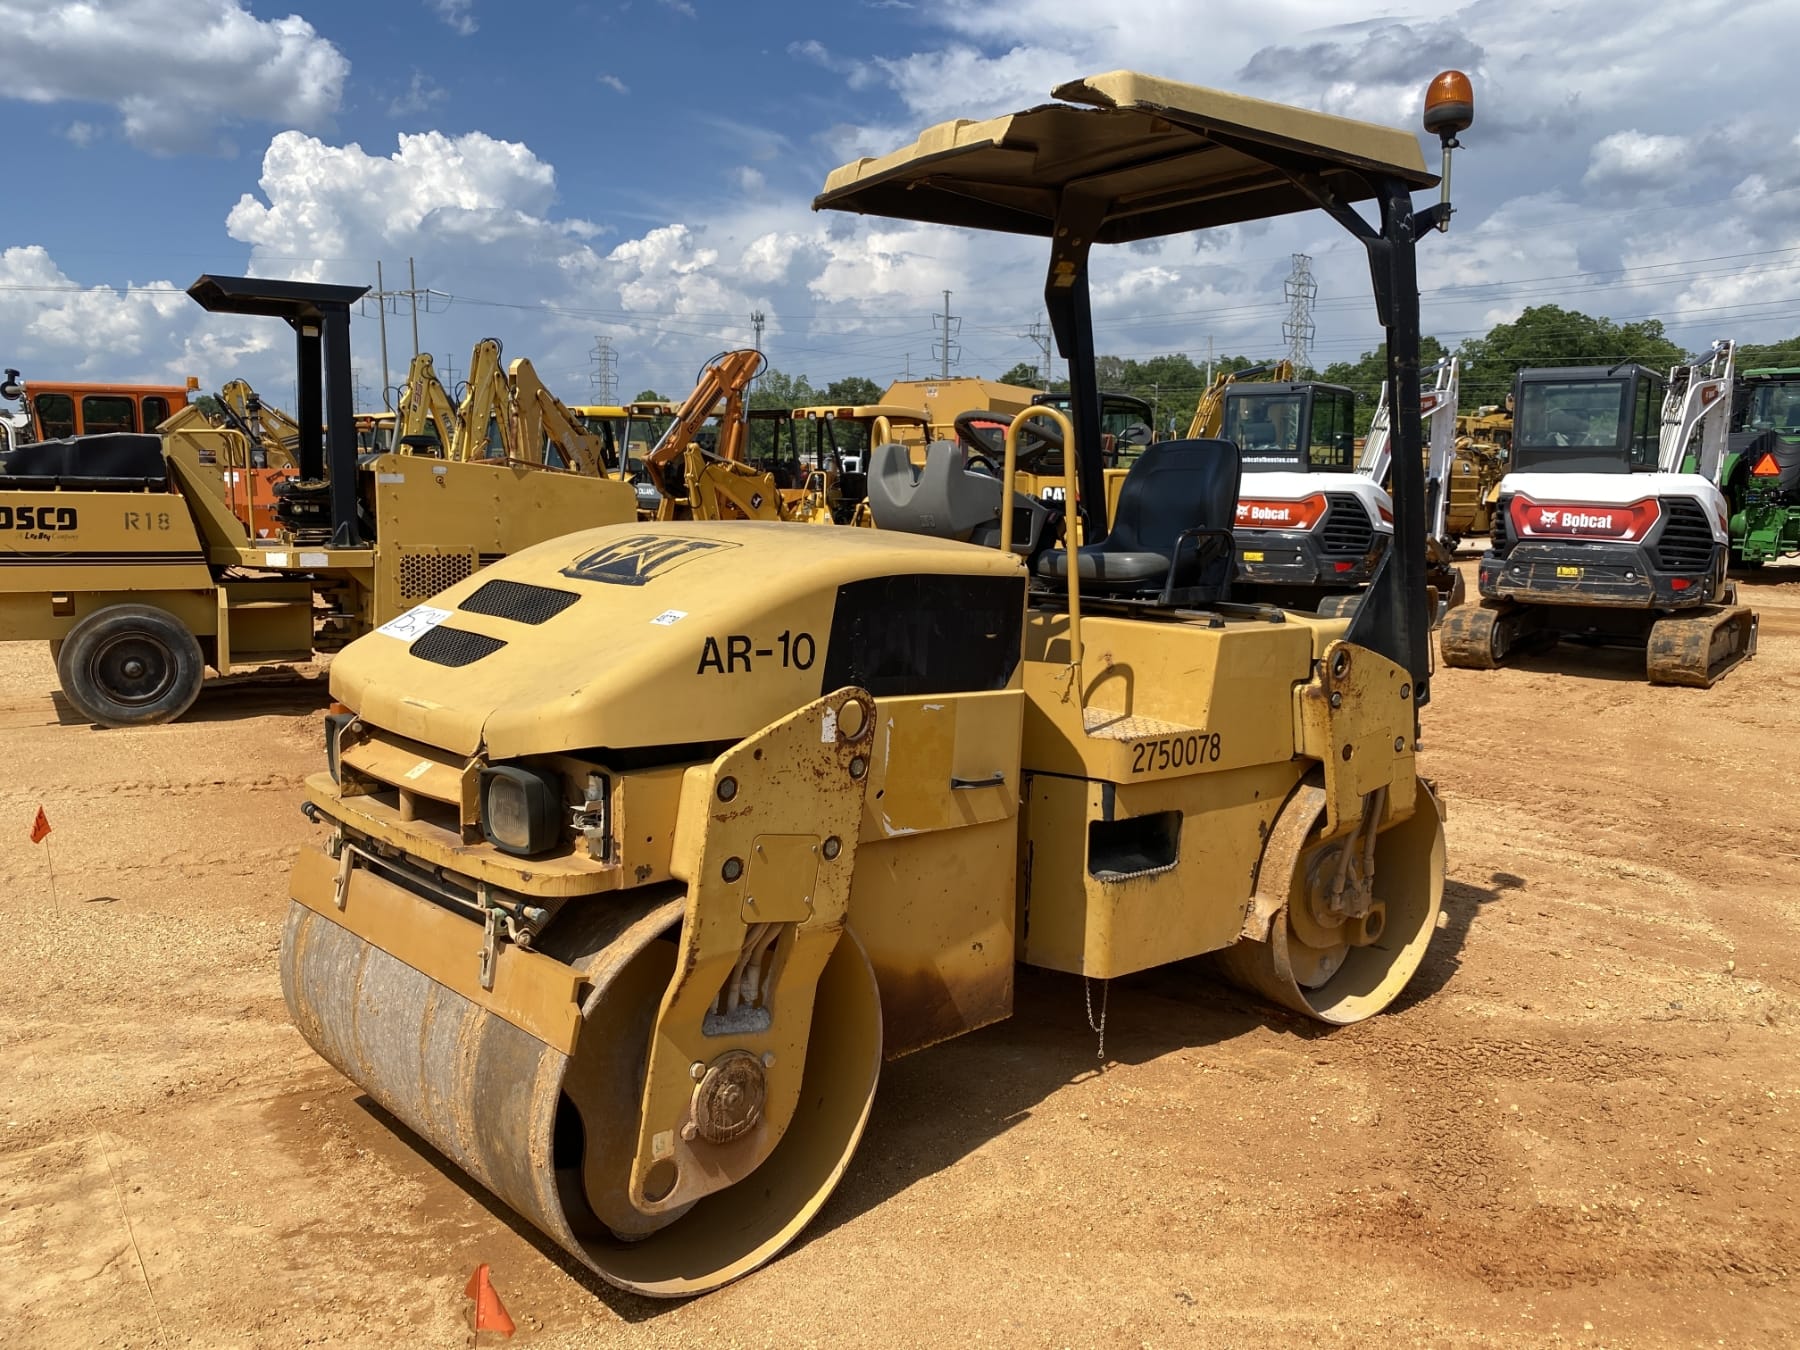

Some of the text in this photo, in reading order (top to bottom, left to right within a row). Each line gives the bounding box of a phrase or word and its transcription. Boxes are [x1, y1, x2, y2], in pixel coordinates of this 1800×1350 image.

[124, 512, 170, 530] R18
[1251, 506, 1289, 520] Bobcat
[1562, 512, 1612, 529] Bobcat
[697, 629, 816, 675] AR-10
[1132, 732, 1221, 773] 2750078
